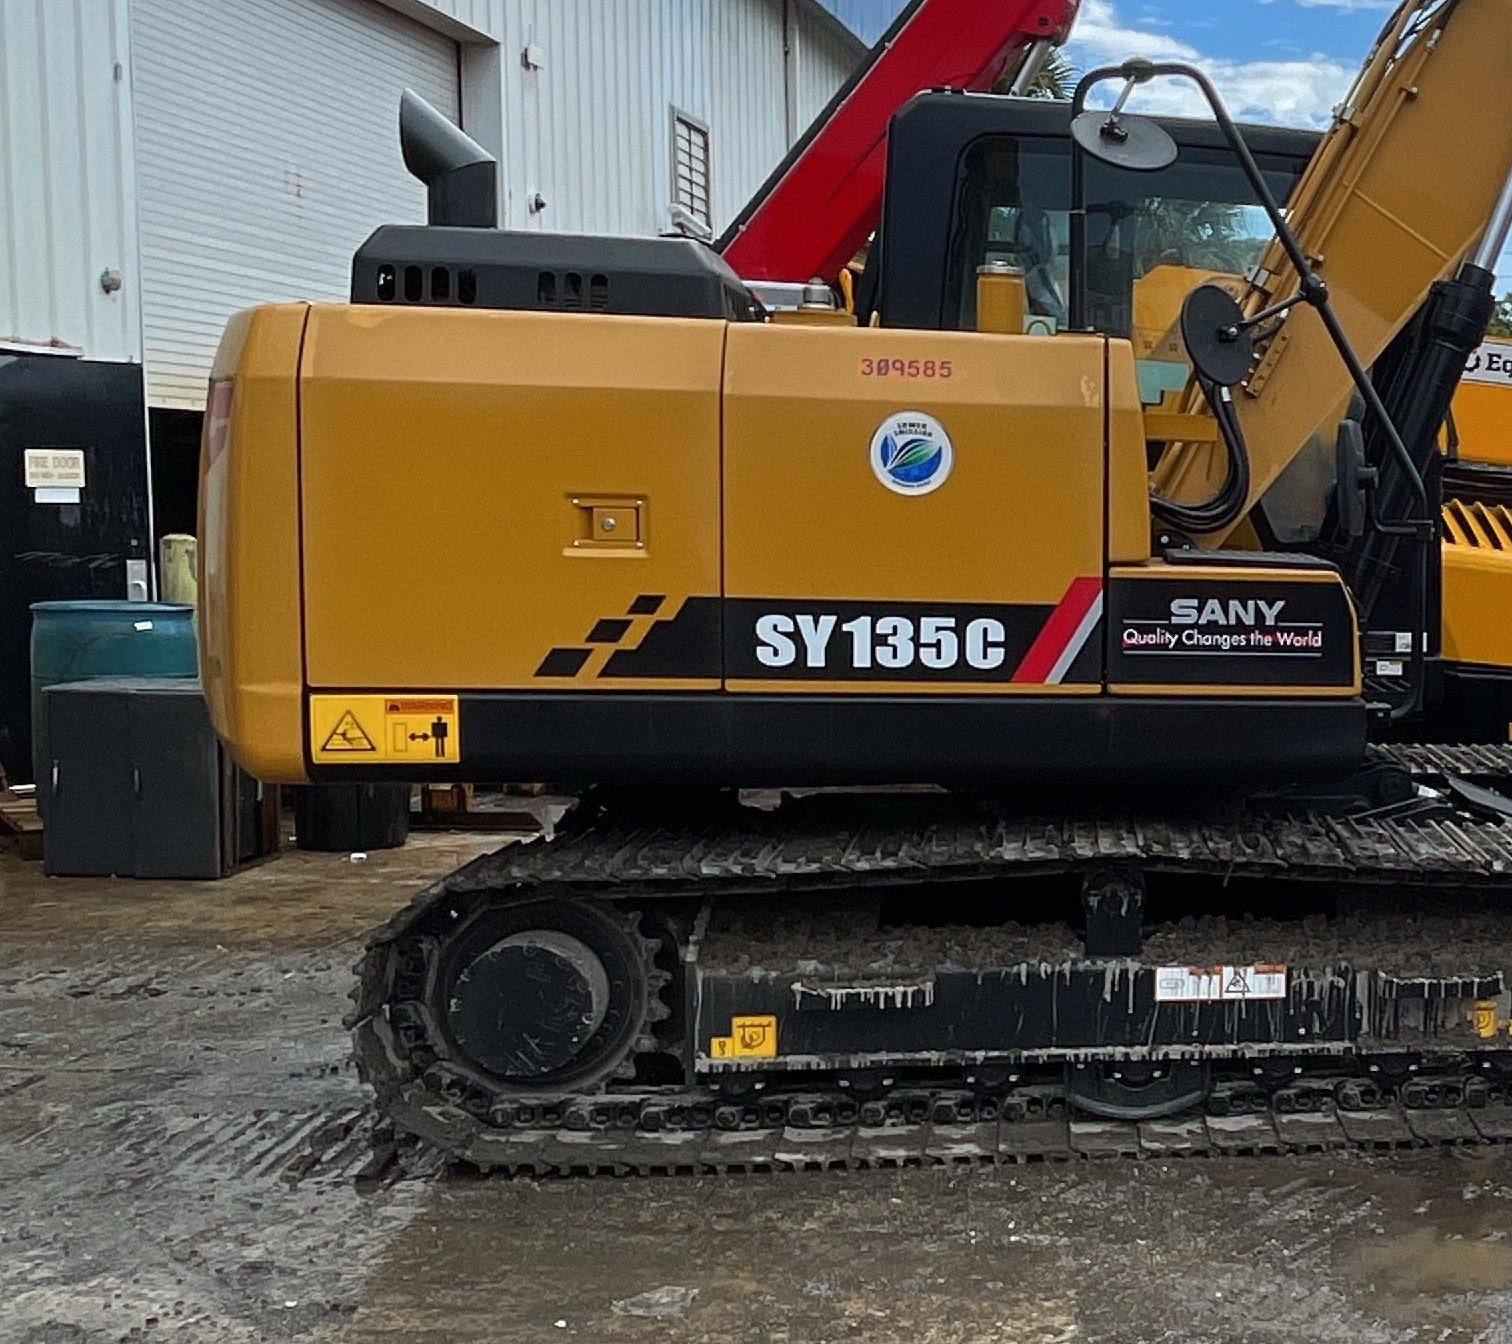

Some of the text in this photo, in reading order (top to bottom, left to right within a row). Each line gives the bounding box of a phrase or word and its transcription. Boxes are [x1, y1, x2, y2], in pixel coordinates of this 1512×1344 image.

[860, 357, 954, 379] 309585
[1169, 598, 1286, 626] SANY
[755, 613, 1007, 670] SY135C
[1122, 627, 1323, 650] Quality Changes the World
